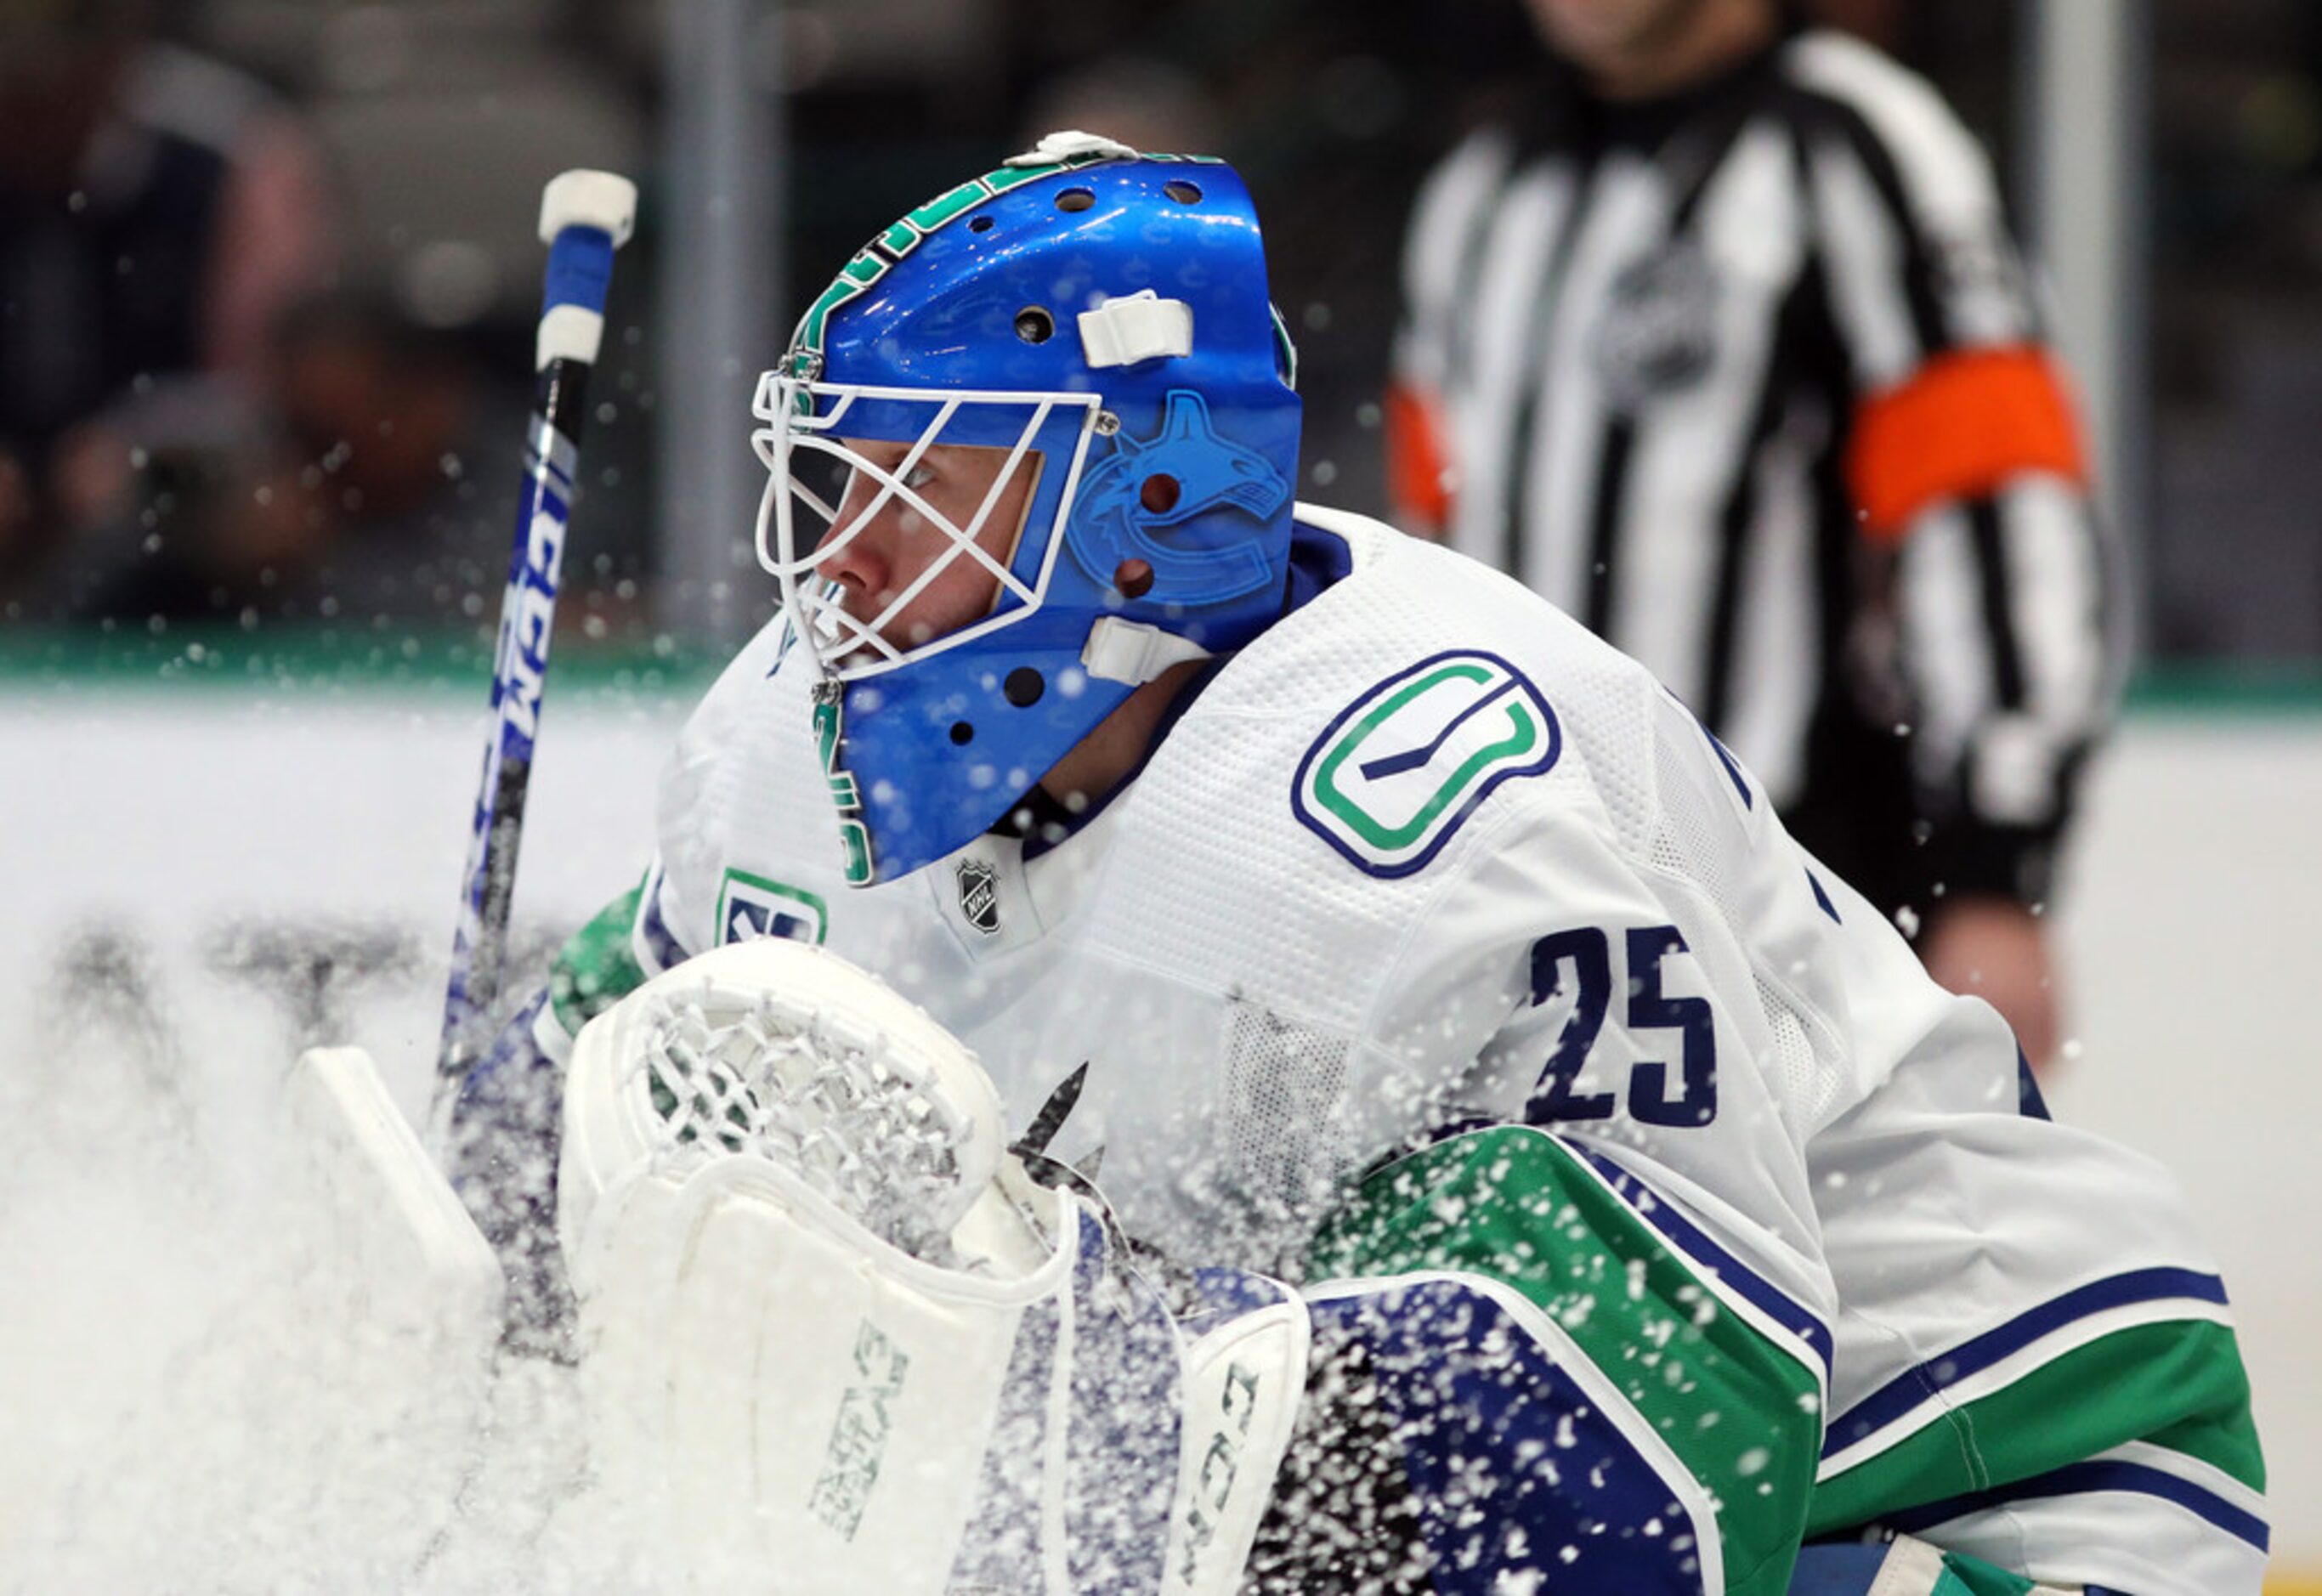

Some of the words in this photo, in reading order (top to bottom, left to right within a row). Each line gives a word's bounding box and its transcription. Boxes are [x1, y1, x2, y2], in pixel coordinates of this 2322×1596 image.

[505, 510, 568, 739] CCM
[967, 884, 993, 918] NHL
[1524, 925, 1718, 1128] 25
